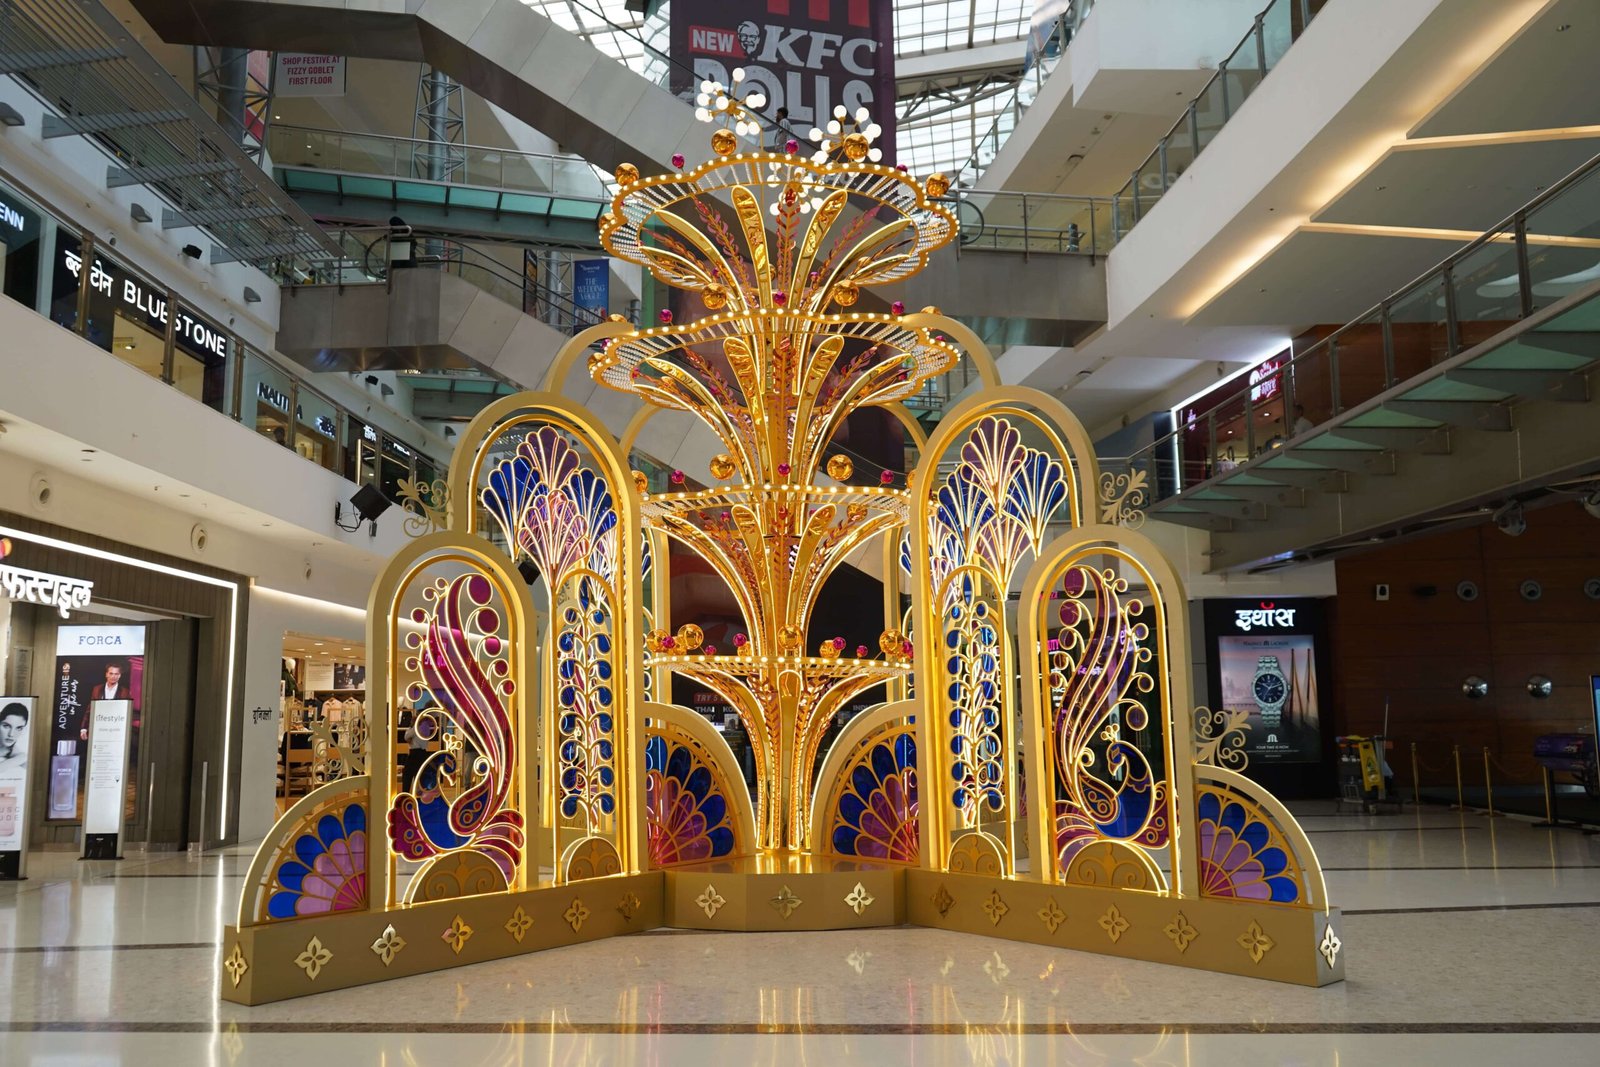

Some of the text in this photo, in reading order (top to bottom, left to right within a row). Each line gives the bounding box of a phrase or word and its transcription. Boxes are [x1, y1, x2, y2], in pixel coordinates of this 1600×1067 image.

[692, 24, 878, 76] NEW KFC
[282, 55, 341, 65] SHOP FESTIVE AT
[287, 66, 335, 75] FIZZY GOBLET
[288, 76, 333, 86] FIRST FLOOR
[257, 381, 303, 420] NAUTIA
[78, 635, 122, 645] FORCA
[58, 662, 71, 730] ADVENTURE IS
[696, 705, 716, 713] THAI
